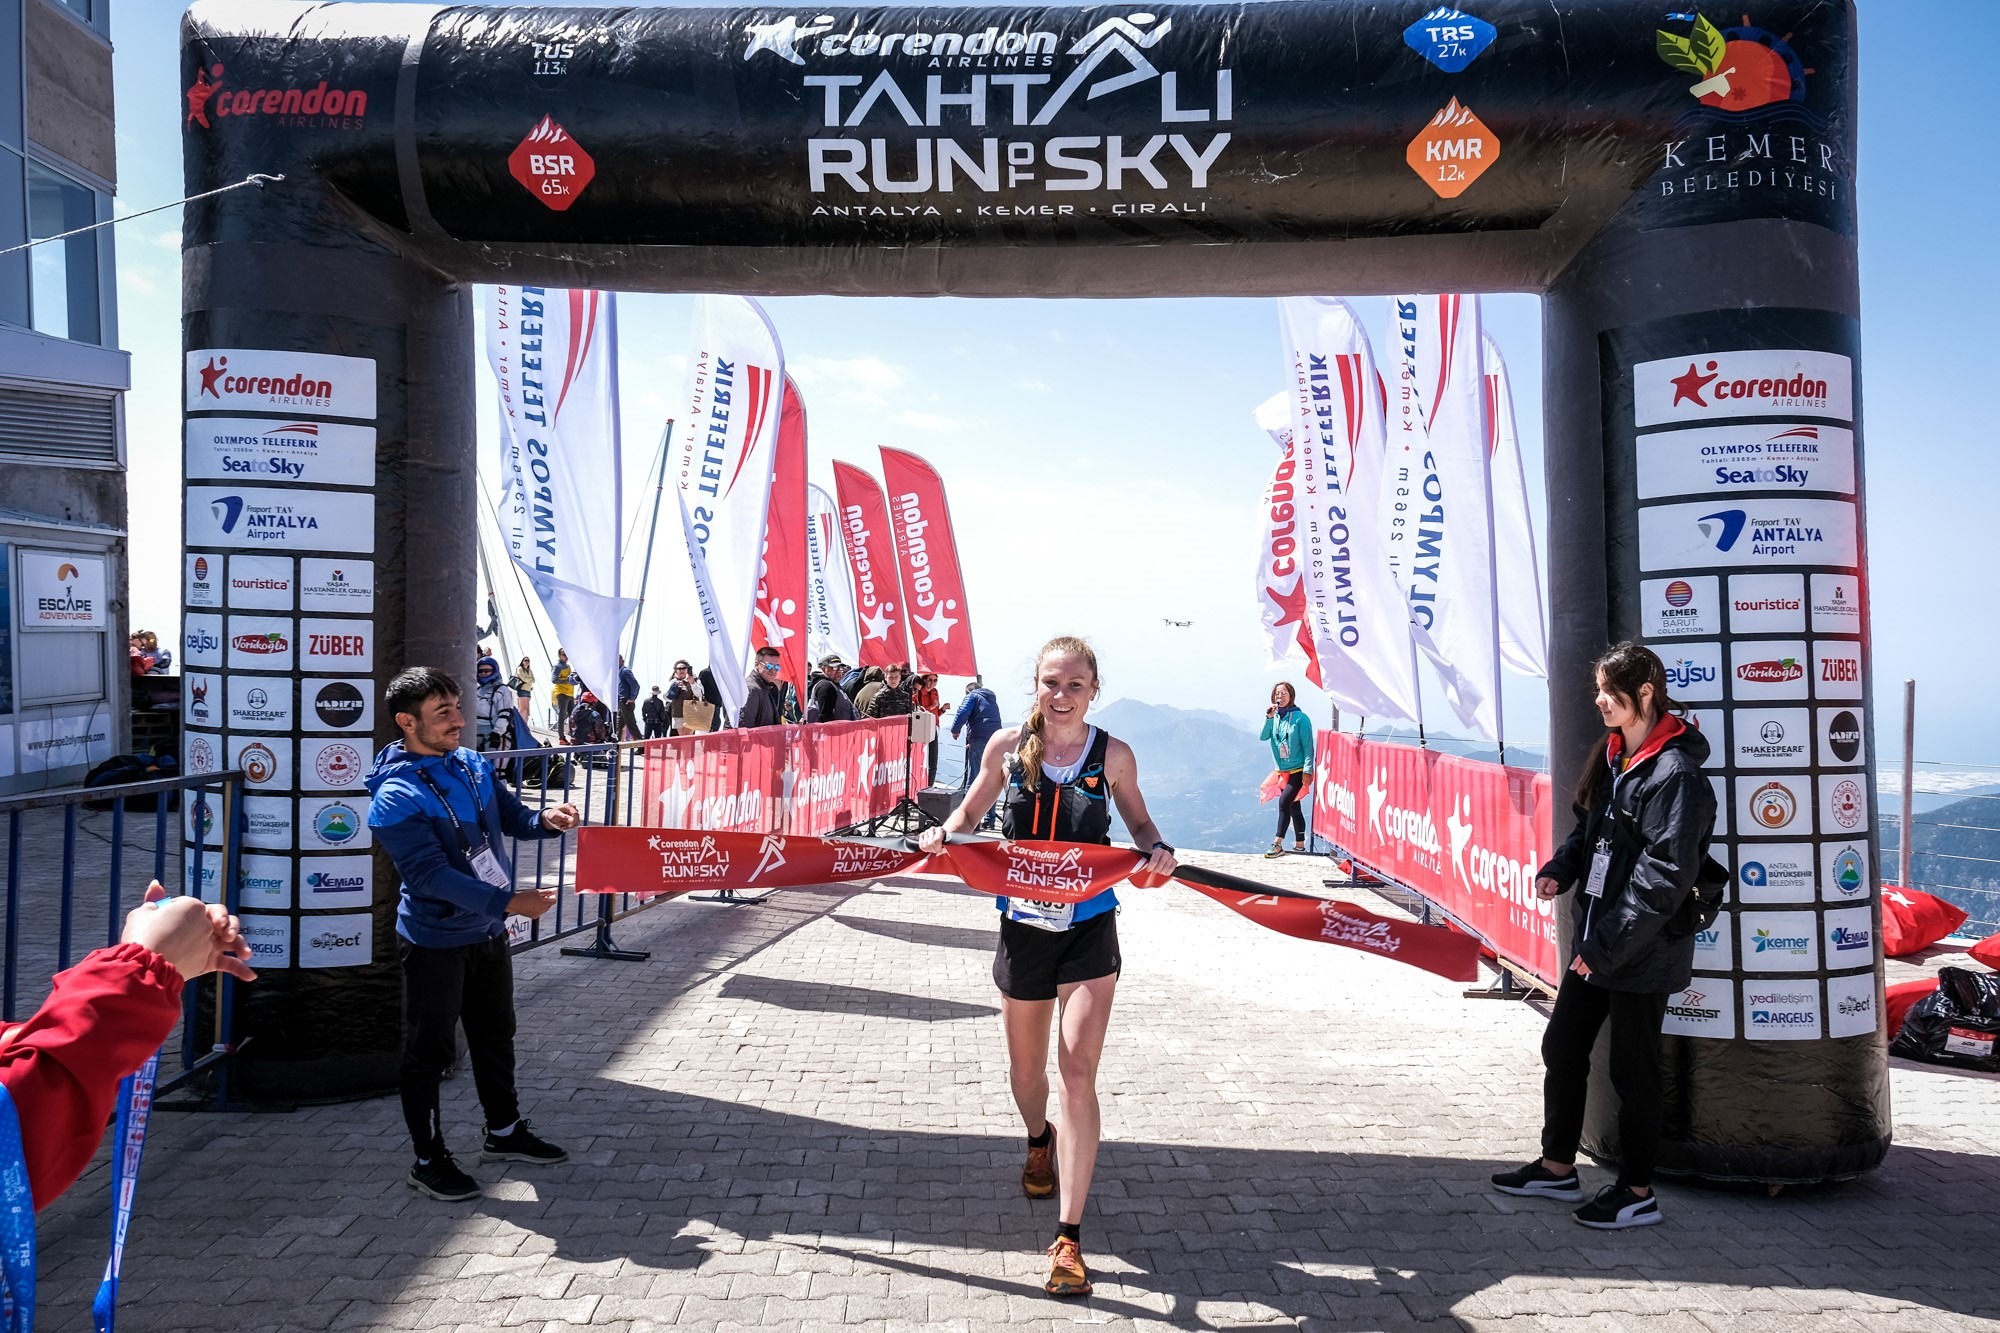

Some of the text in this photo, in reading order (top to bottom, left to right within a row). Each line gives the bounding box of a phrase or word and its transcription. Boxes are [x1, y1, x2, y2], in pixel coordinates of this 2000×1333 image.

[1426, 26, 1474, 42] TRS
[820, 27, 1057, 57] corendon
[532, 43, 575, 59] TUS
[928, 56, 1054, 68] AIRLINES
[217, 81, 367, 117] corendon
[277, 116, 364, 130] AIRLINES
[1426, 137, 1482, 162] KMR
[1663, 133, 1834, 172] KEMER
[529, 154, 575, 175] BSR
[1661, 169, 1836, 200] BELEDİYESİ
[812, 205, 941, 216] ANTALYA
[978, 205, 1075, 216] KEMER
[224, 373, 332, 398] corendon
[1714, 373, 1827, 400] corendon
[269, 396, 331, 407] AIRLINES
[1772, 399, 1827, 408] AIRLINES
[213, 435, 318, 449] OLYMPOS TELEFERIK
[1701, 444, 1818, 455] OLYMPOS TELEFERIK
[246, 505, 294, 514] Fraport TAV
[247, 514, 318, 529] ANTALYA
[1751, 518, 1802, 527] Fraport TAV
[247, 529, 285, 541] Airport
[1752, 527, 1823, 542] ANTALYA
[1752, 544, 1795, 556] Airport
[38, 597, 92, 612] ESCAPE
[39, 612, 92, 621] ADVENTURES
[1661, 608, 1697, 617] KEMER
[1662, 618, 1697, 627] BARUT
[308, 634, 364, 656] ZÜBER
[1665, 666, 1715, 688] eysu
[1821, 658, 1858, 682] ZÜBER
[233, 709, 285, 718] SHAKESPEARE
[1741, 745, 1803, 754] SHAKESPEARE
[872, 751, 907, 787] corendo
[1385, 804, 1441, 860] corendo
[661, 839, 699, 848] corendon
[1012, 845, 1060, 860] corendon
[246, 878, 284, 888] kemer
[1470, 844, 1556, 921] corendo
[238, 926, 285, 937] ediiletişim
[1509, 909, 1557, 945] AIRLINE
[1766, 937, 1810, 948] kemer
[1666, 1005, 1720, 1019] ROSSIST
[1770, 1012, 1814, 1024] ARGEUS
